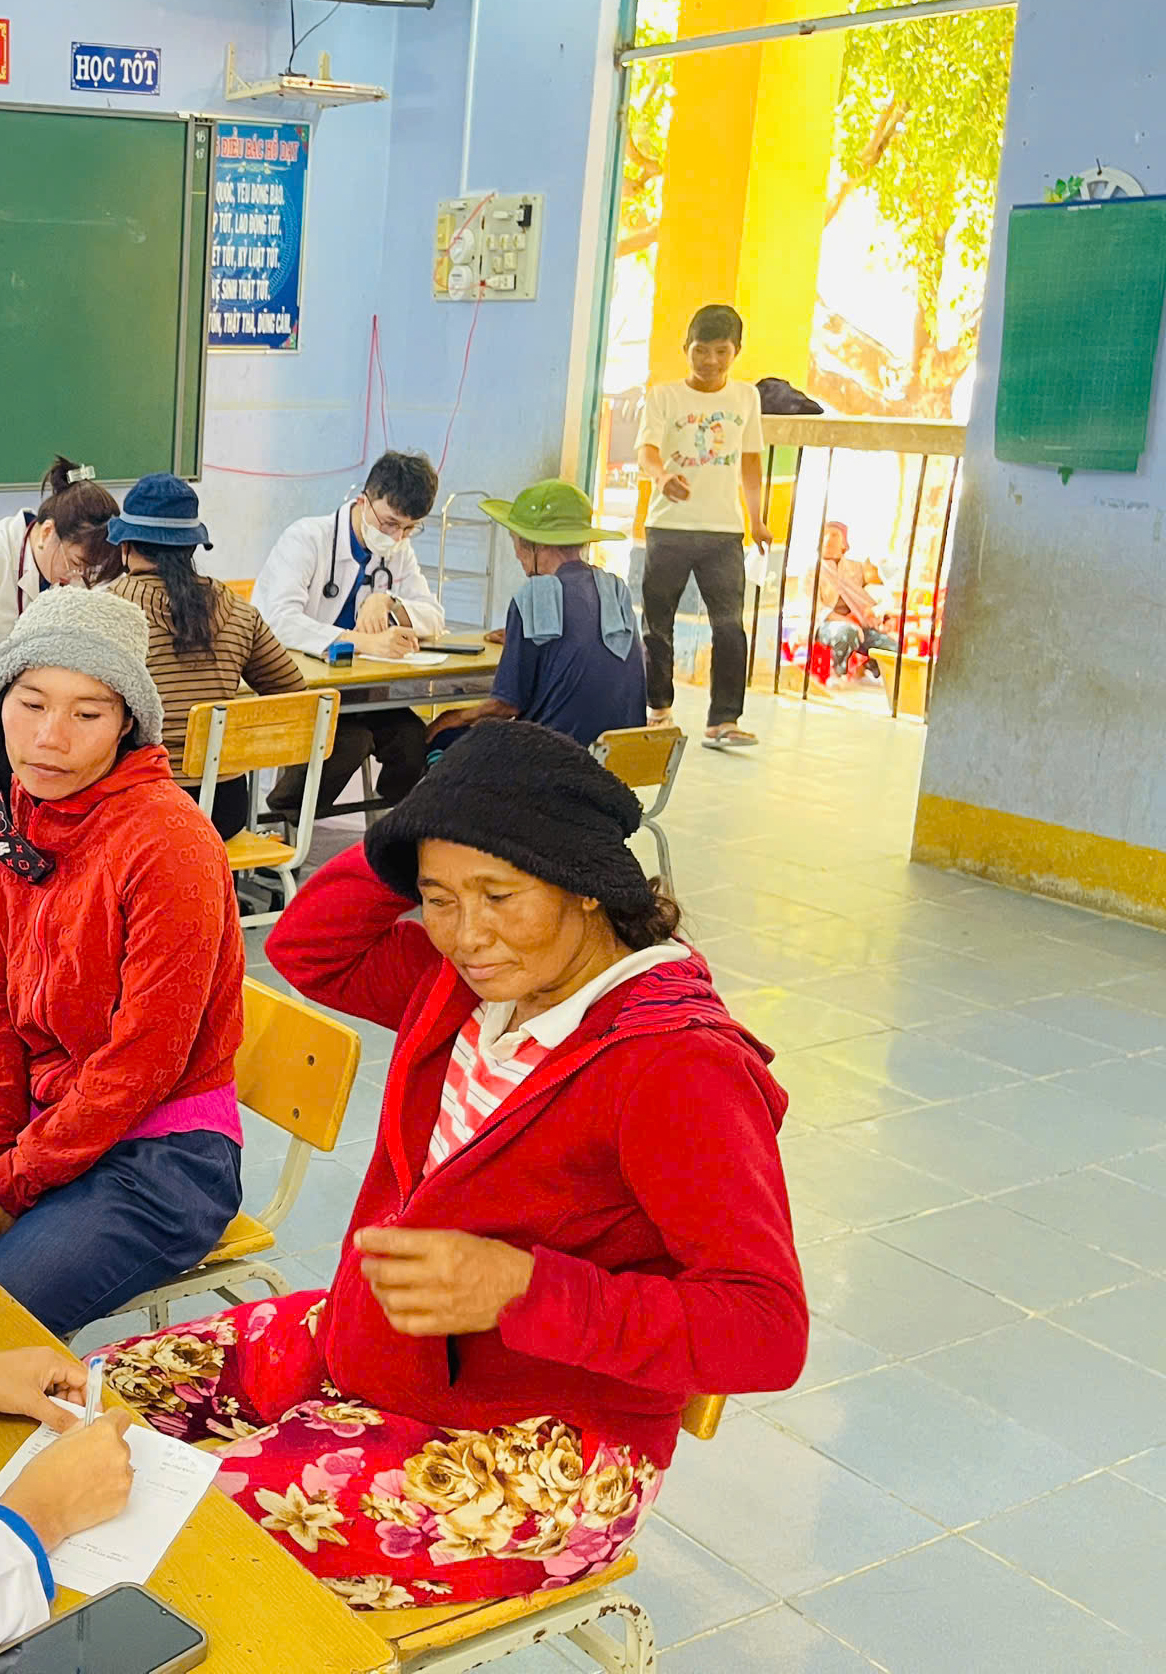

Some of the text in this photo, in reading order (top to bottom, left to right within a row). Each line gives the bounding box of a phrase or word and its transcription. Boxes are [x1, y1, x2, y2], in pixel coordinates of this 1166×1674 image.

[75, 51, 156, 88] HỌC TỐT
[221, 126, 244, 159] ĐIỀU
[245, 133, 264, 159] BÁC
[264, 129, 279, 161] HỒ
[279, 140, 300, 167] DẠY
[212, 237, 221, 267] ẾT
